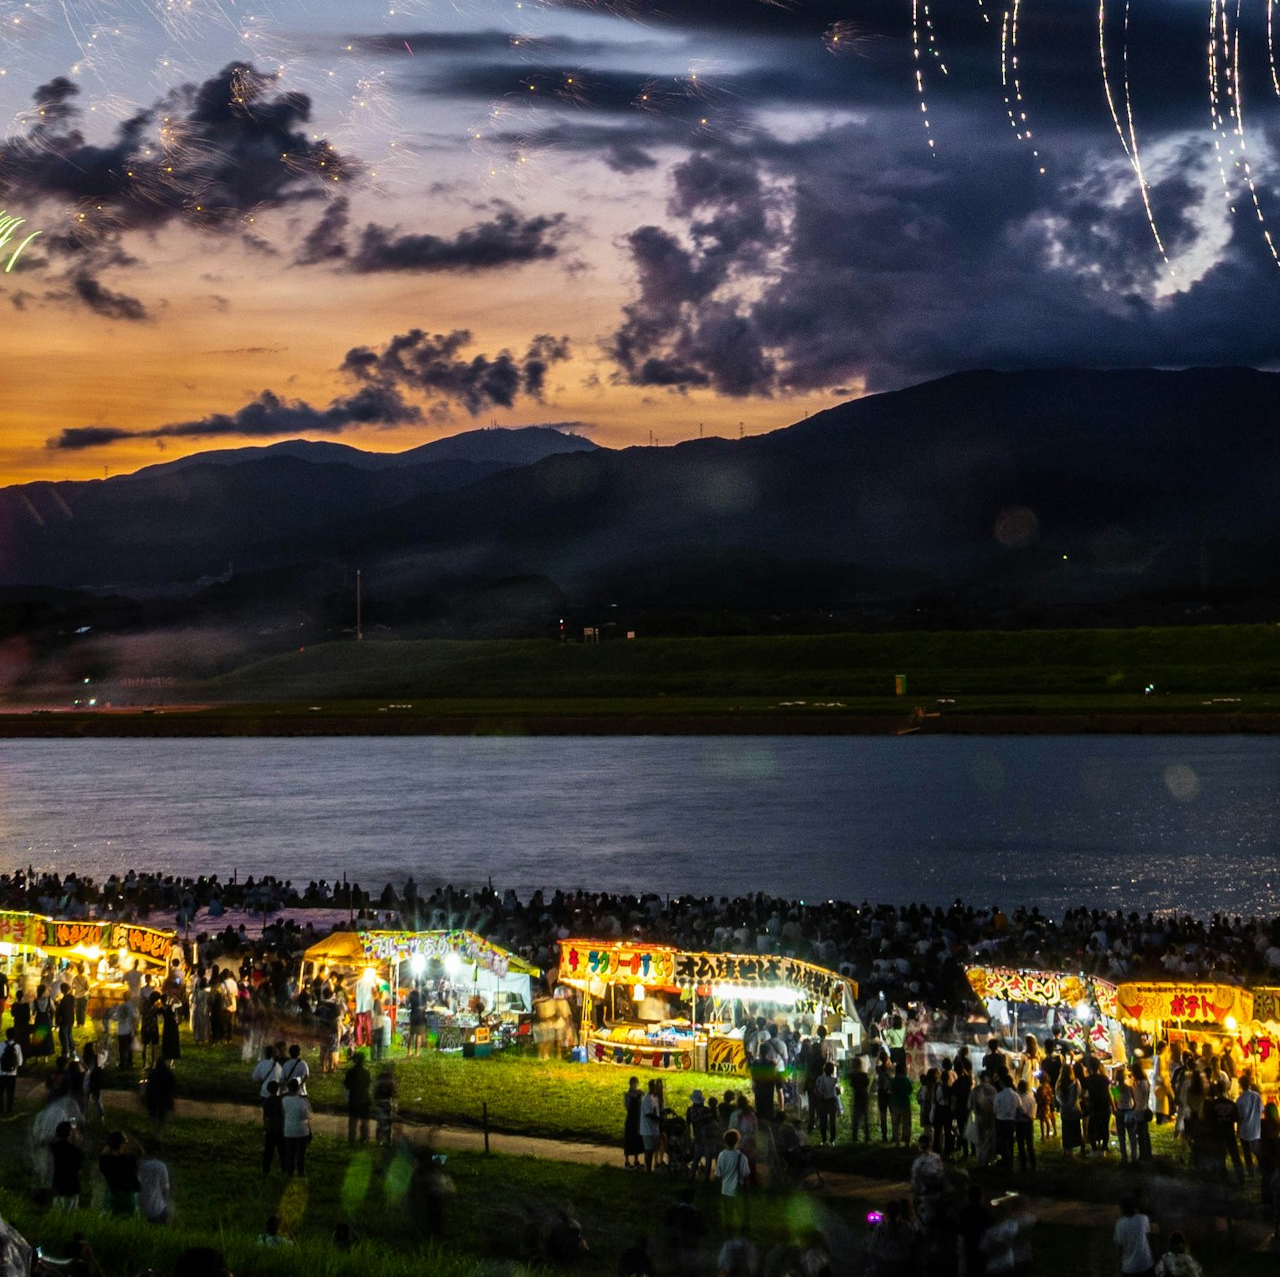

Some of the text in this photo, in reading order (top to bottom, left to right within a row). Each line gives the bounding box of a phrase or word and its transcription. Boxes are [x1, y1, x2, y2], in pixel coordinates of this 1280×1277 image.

[985, 973, 1061, 1006] やきとり
[1170, 994, 1215, 1018] ポテト
